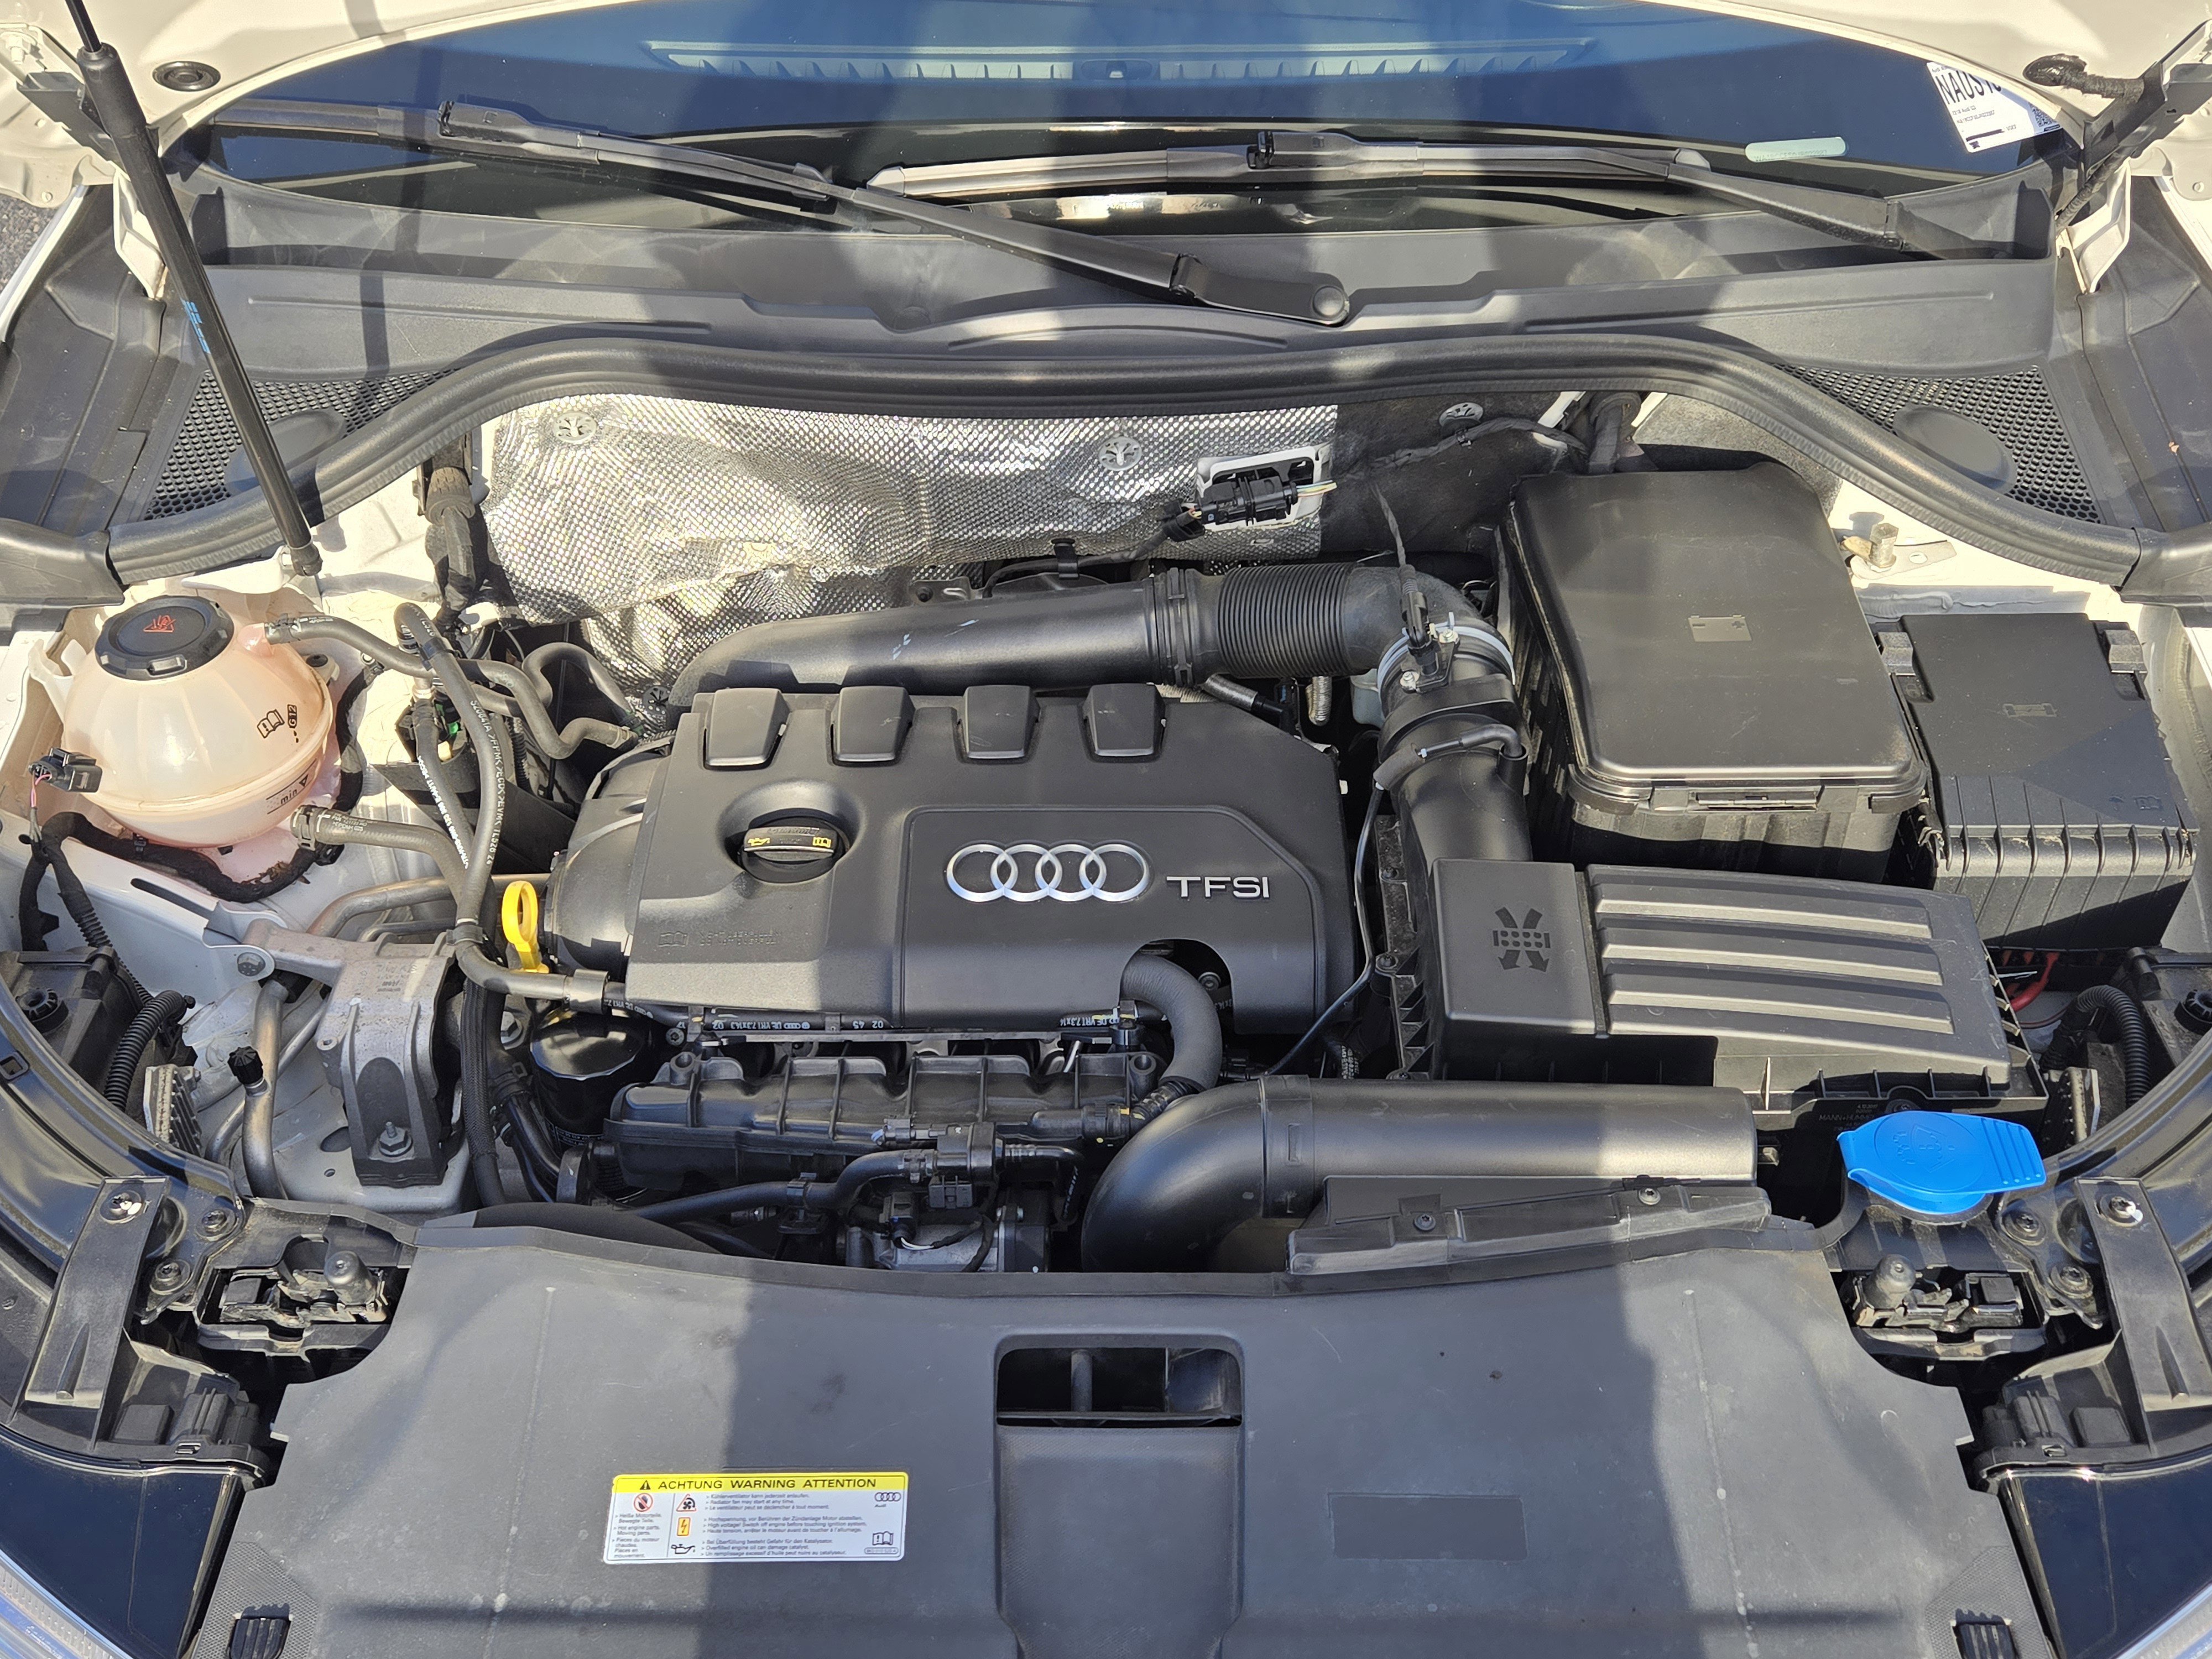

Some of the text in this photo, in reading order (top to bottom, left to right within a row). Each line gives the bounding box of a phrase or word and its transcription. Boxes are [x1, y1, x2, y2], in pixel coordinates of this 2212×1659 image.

[288, 705, 296, 726] G12
[280, 788, 298, 805] min
[1166, 877, 1270, 899] TFSI
[852, 1020, 884, 1029] 02 45
[658, 1478, 877, 1490] ACHTUNG WARNING ATTENTION
